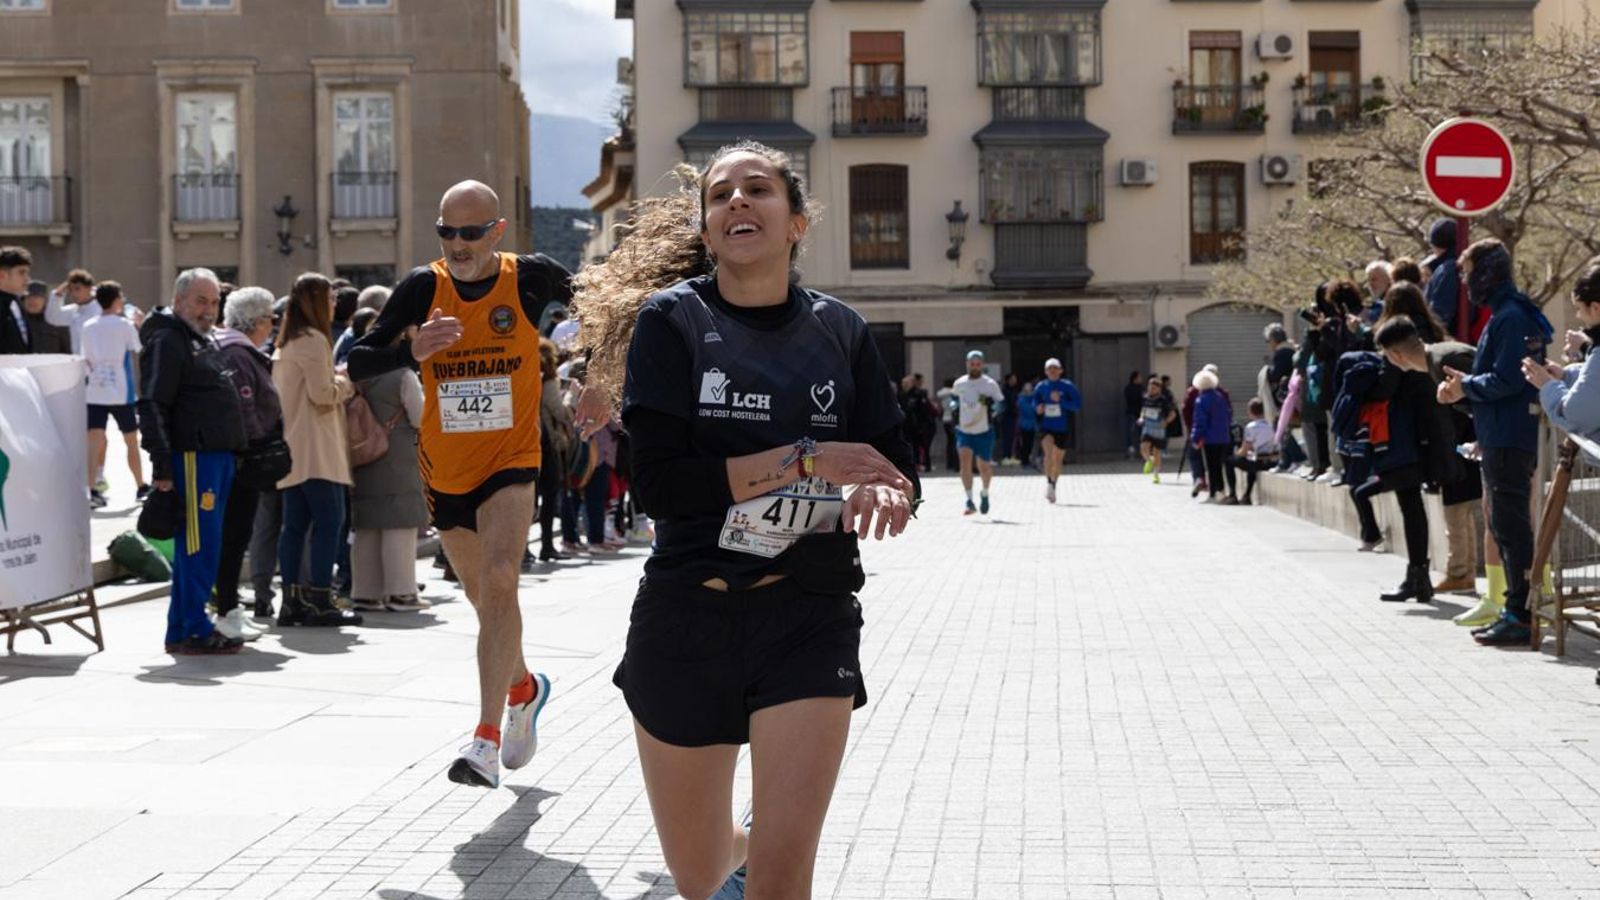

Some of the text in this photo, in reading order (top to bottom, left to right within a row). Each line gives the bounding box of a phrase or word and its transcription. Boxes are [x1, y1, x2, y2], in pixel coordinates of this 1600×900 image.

[457, 396, 493, 414] 442
[732, 392, 771, 409] LCH
[698, 408, 712, 417] LOW
[713, 409, 730, 418] COST
[762, 497, 816, 529] 411
